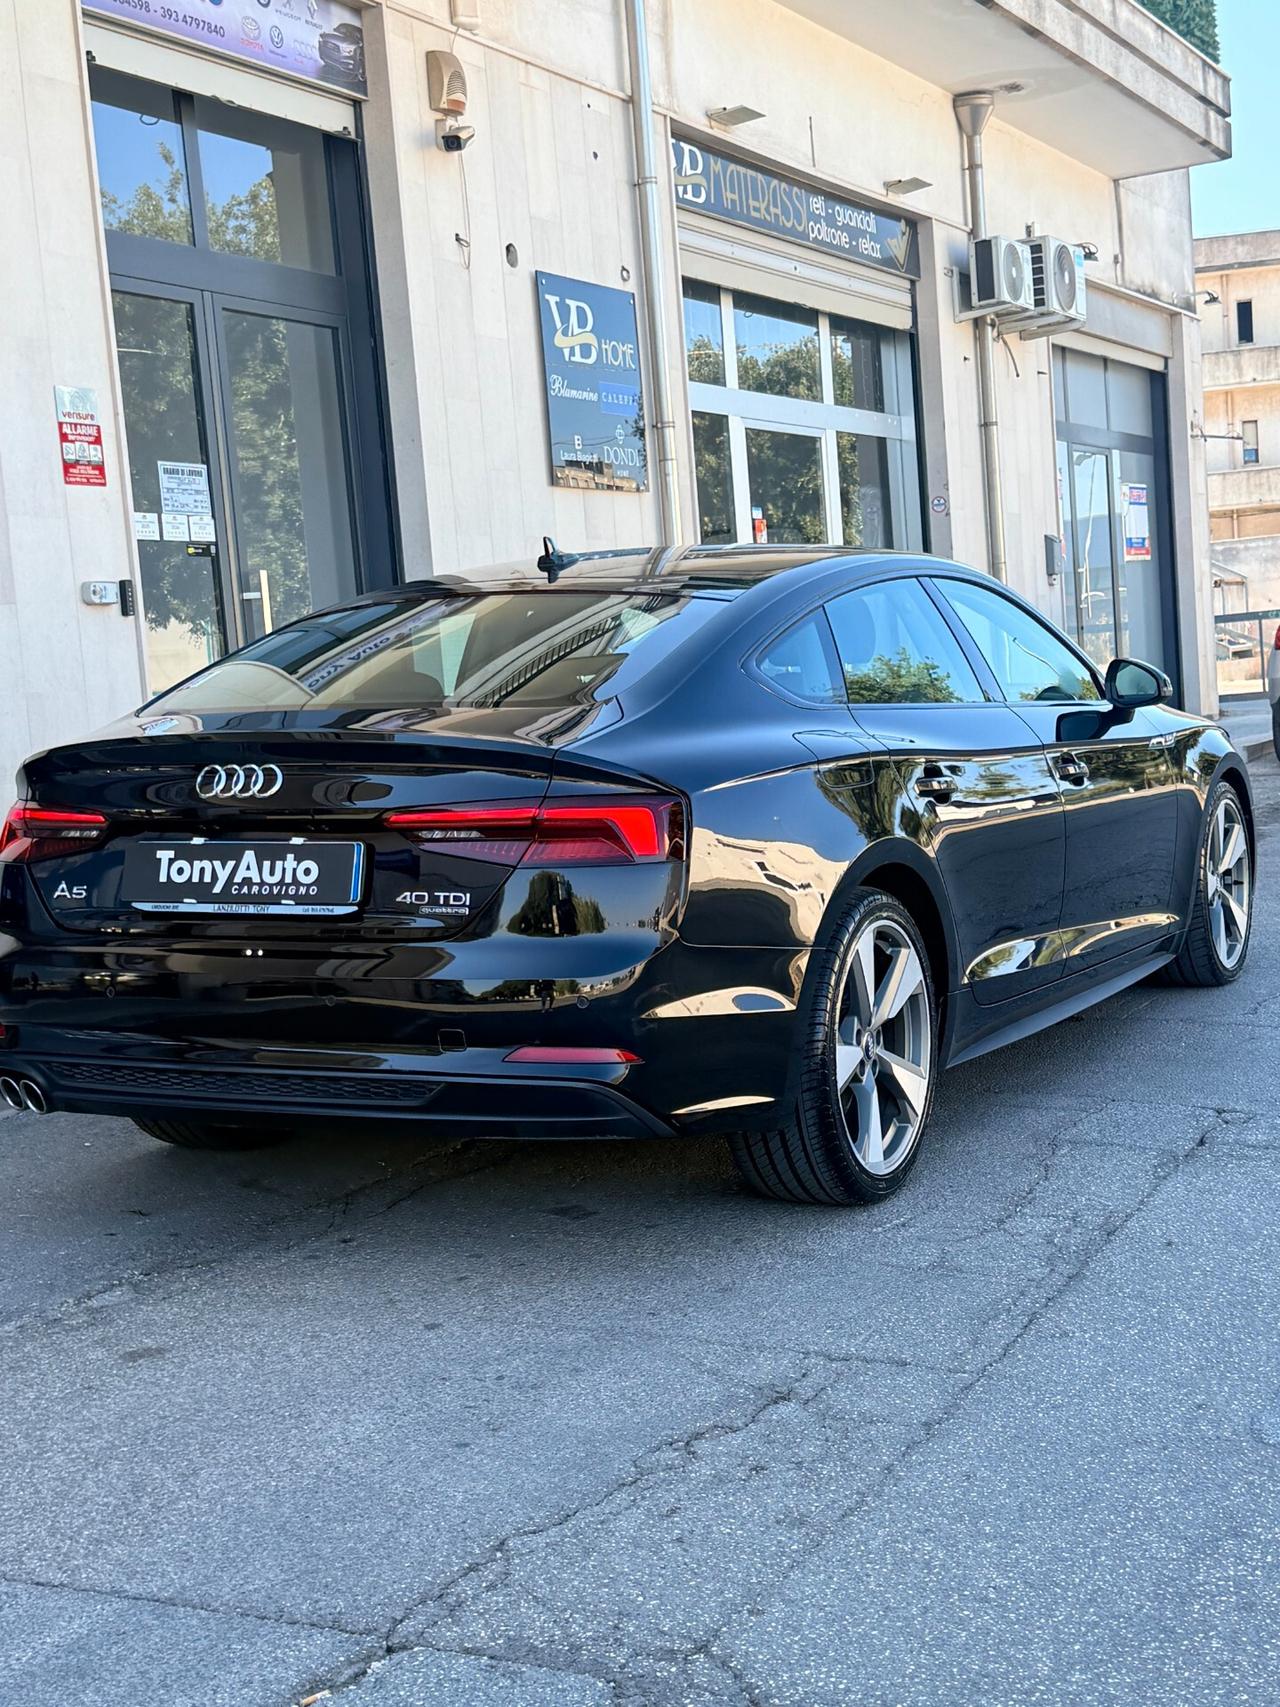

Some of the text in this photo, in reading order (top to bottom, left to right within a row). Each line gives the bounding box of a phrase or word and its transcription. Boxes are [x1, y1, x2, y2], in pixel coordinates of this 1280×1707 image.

[160, 6, 180, 22] 393
[181, 14, 226, 38] 4797840
[709, 155, 809, 235] MATERASSI
[809, 195, 827, 217] reti
[834, 205, 878, 234] guanciali
[808, 218, 850, 249] poltrone
[859, 234, 882, 259] relax
[601, 338, 636, 369] HOME
[62, 423, 99, 437] ALLARME
[603, 446, 640, 467] DONDI
[53, 880, 88, 899] A5
[231, 885, 318, 895] CAROVIGNO
[396, 891, 471, 906] 40 TDI
[420, 907, 467, 915] quattro
